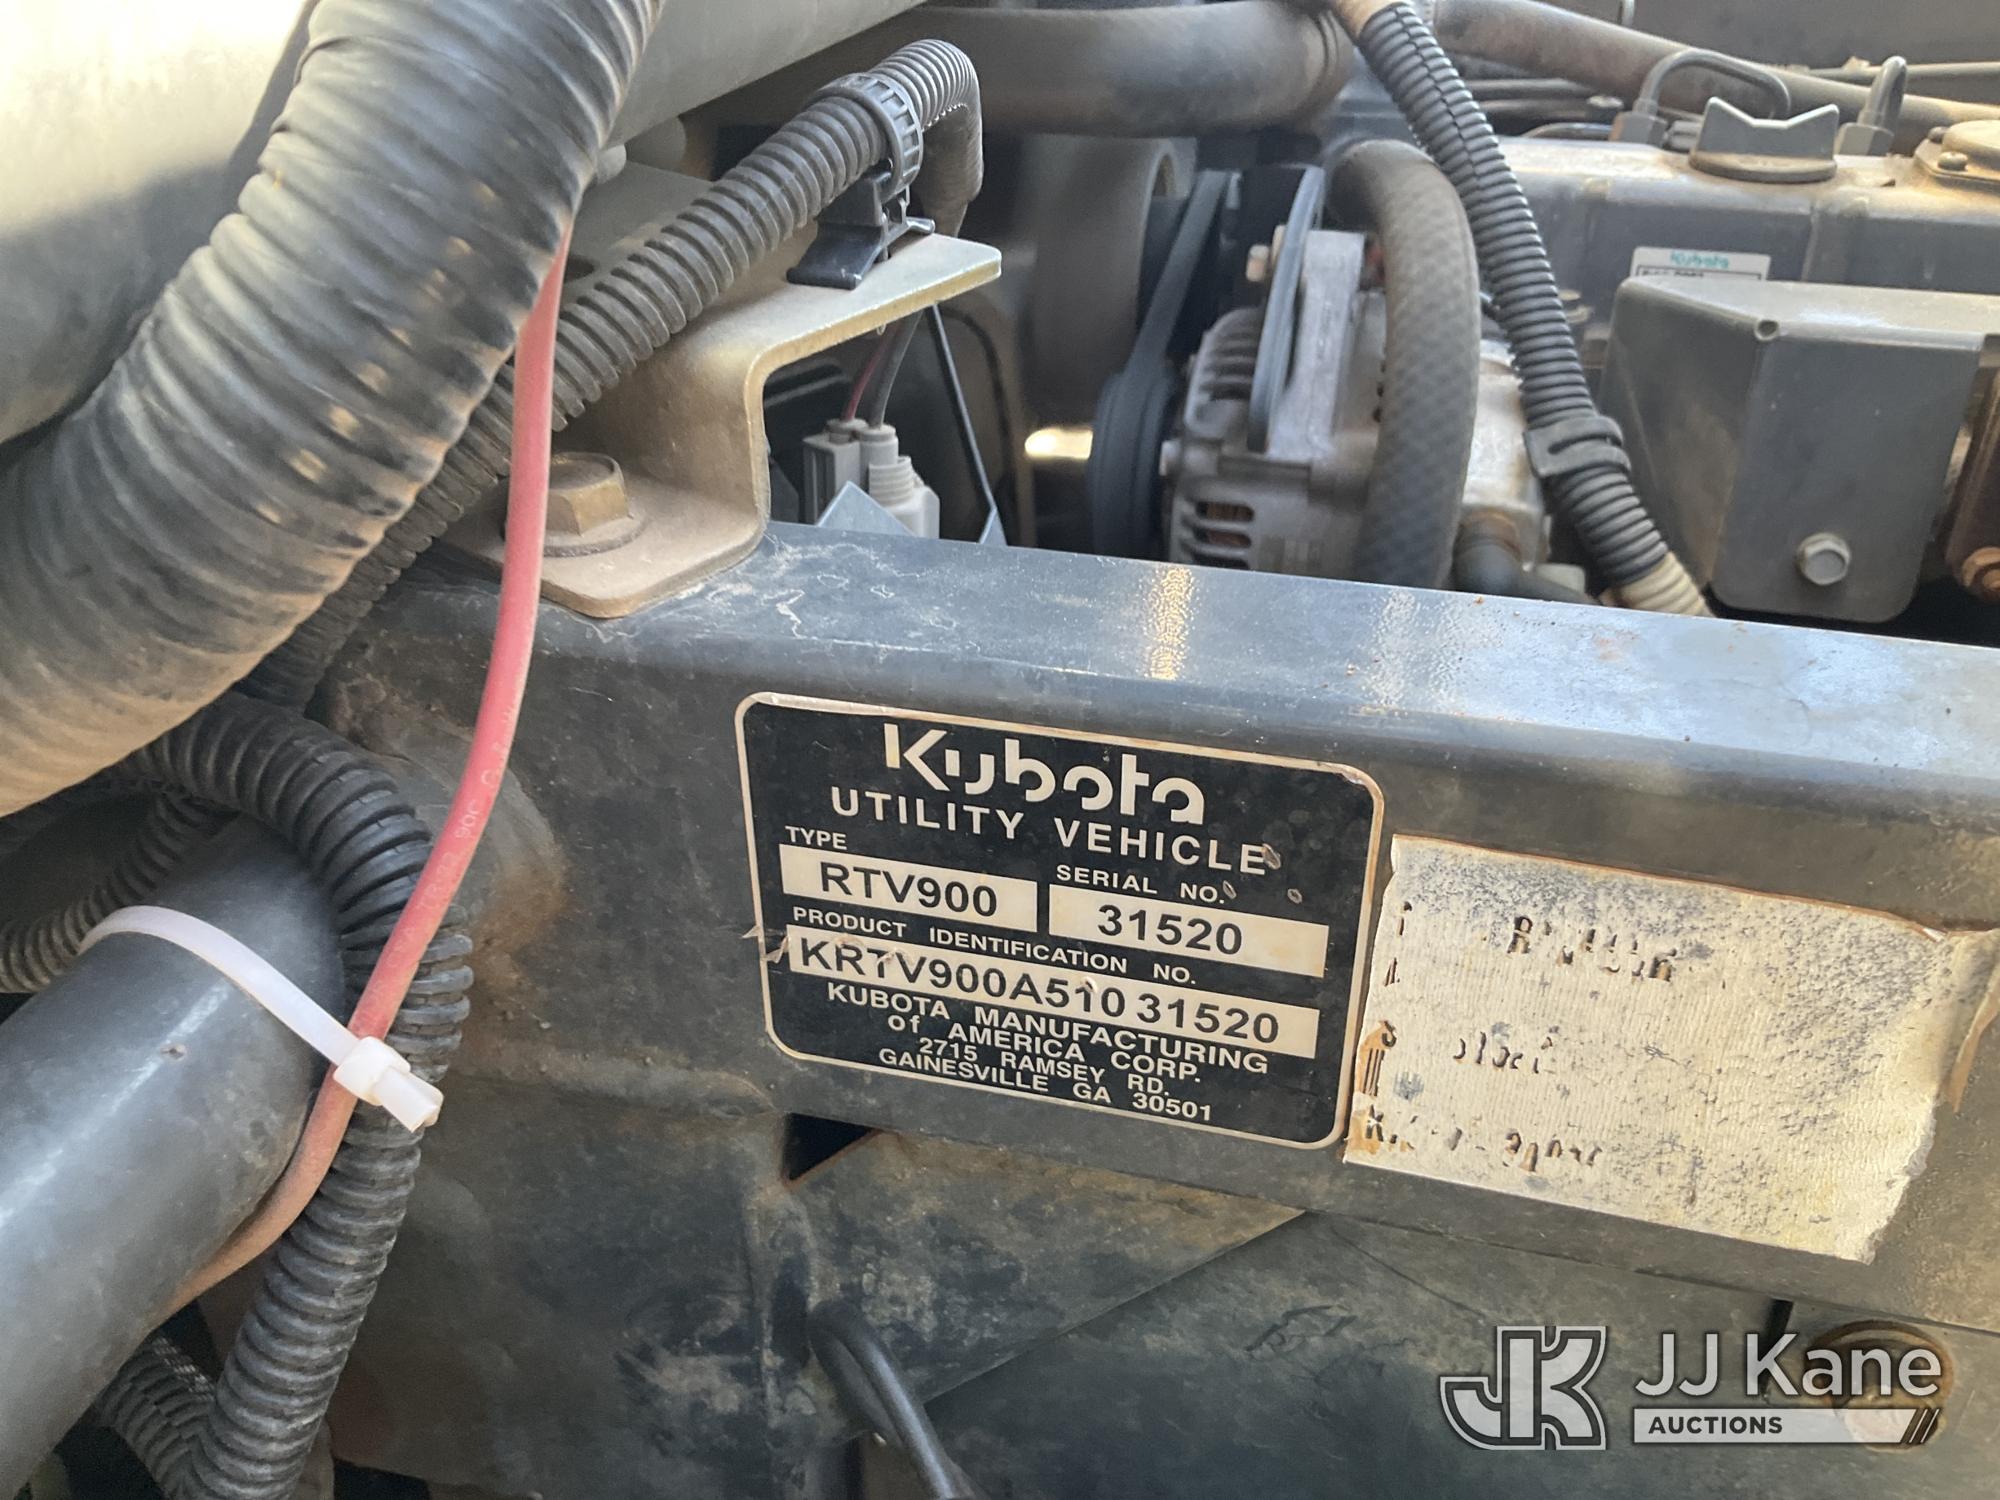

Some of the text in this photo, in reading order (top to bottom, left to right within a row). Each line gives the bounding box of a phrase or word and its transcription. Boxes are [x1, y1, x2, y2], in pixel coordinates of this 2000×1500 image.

[884, 723, 1205, 826] Kubota
[785, 825, 848, 850] TYPE
[831, 786, 1267, 876] UTILITY VEHICLE
[819, 861, 998, 917] RTV900
[1056, 864, 1226, 904] SERIAL NO.
[793, 905, 1197, 985] PRODUCT IDENTIFICATION NO.
[1097, 904, 1243, 955] 31520
[827, 981, 1268, 1075] KUBOTA MANUFACTURING
[948, 1022, 1086, 1062] AMERICA
[1110, 1050, 1201, 1083] CORP.
[879, 1047, 1211, 1121] GAINESVILLE GA 30501
[919, 1036, 1169, 1096] 2715 RAMSEY RD.
